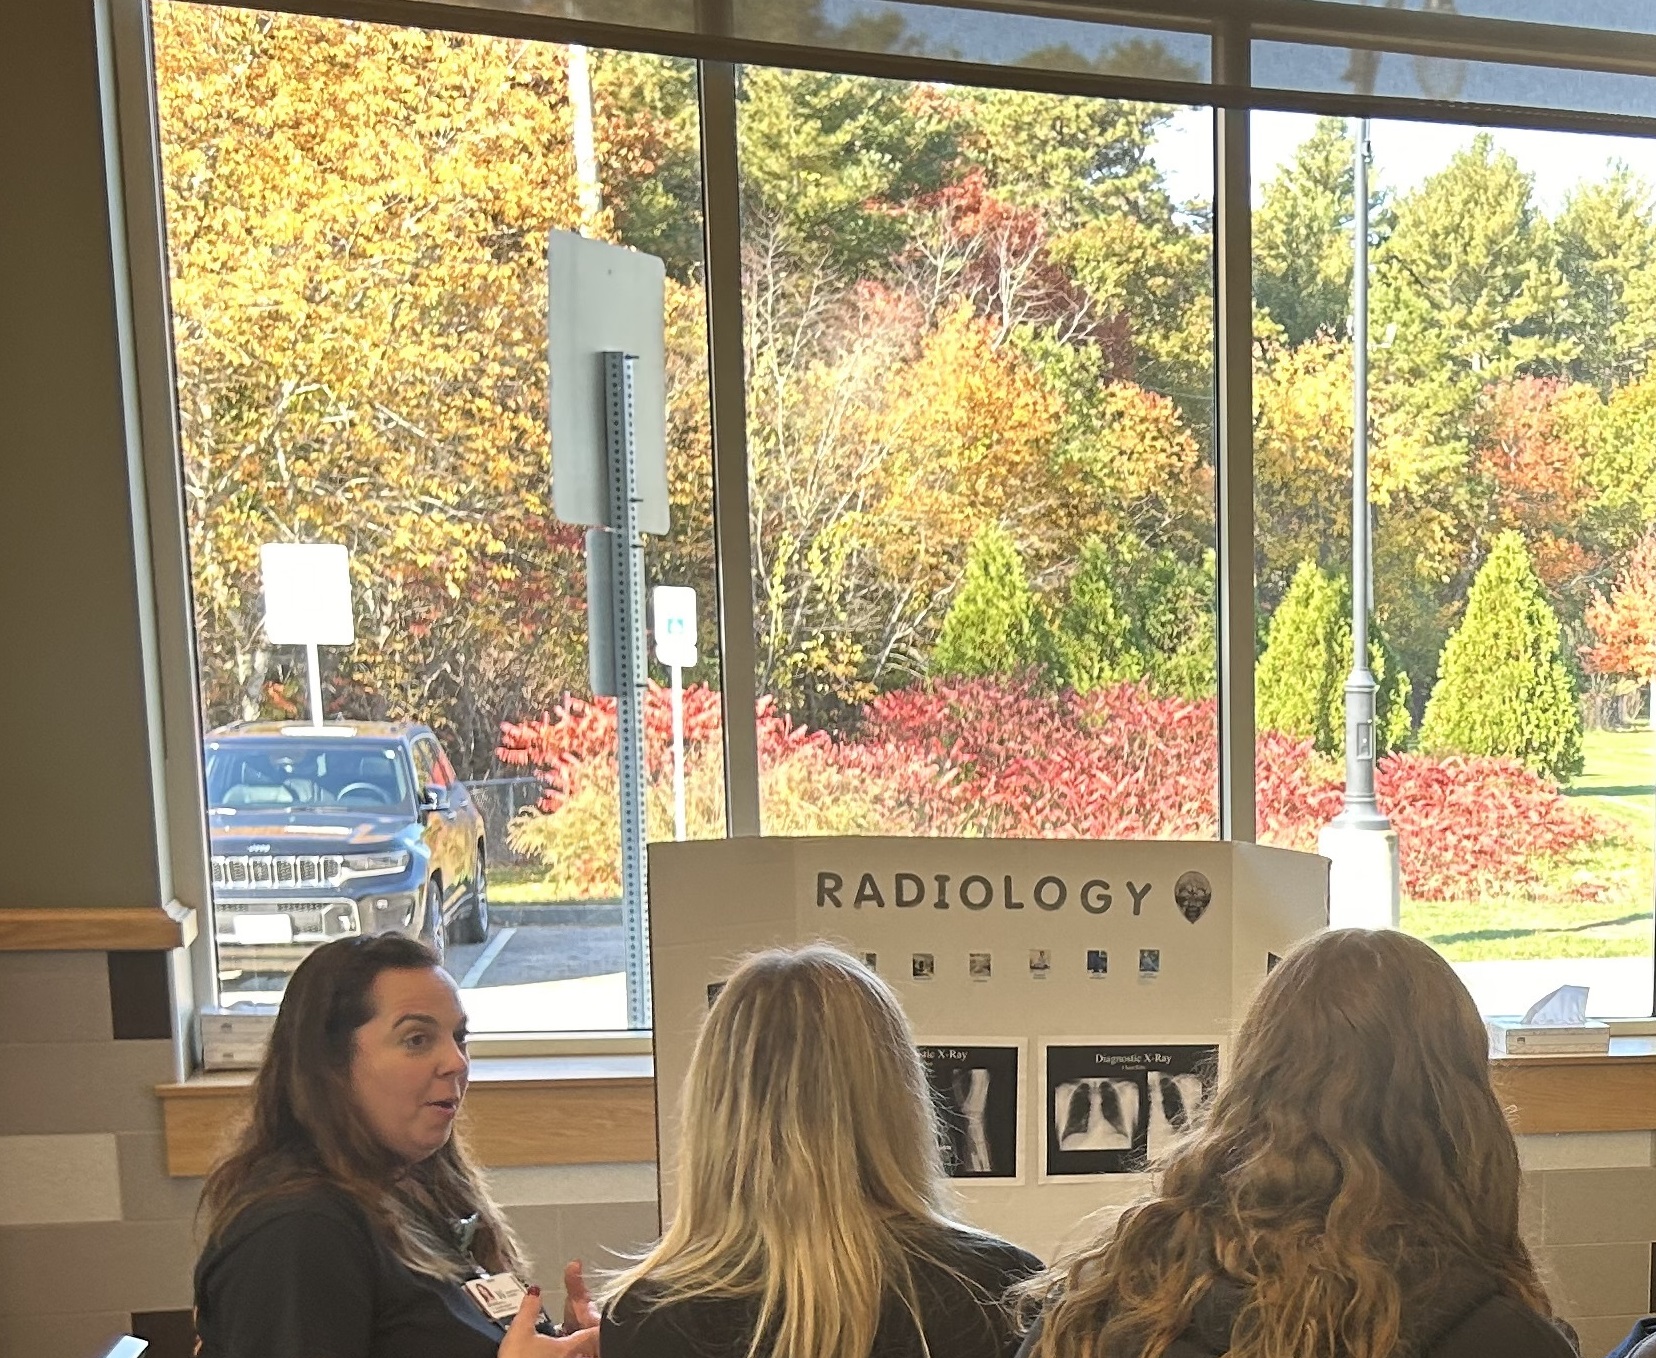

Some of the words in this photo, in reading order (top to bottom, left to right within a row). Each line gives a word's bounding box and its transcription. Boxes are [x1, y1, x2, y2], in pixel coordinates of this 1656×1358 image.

[816, 872, 1153, 916] RADIOLOGY
[937, 1049, 968, 1062] X-Ray
[1095, 1053, 1142, 1066] Diagnostic
[1143, 1053, 1172, 1065] X-Ray
